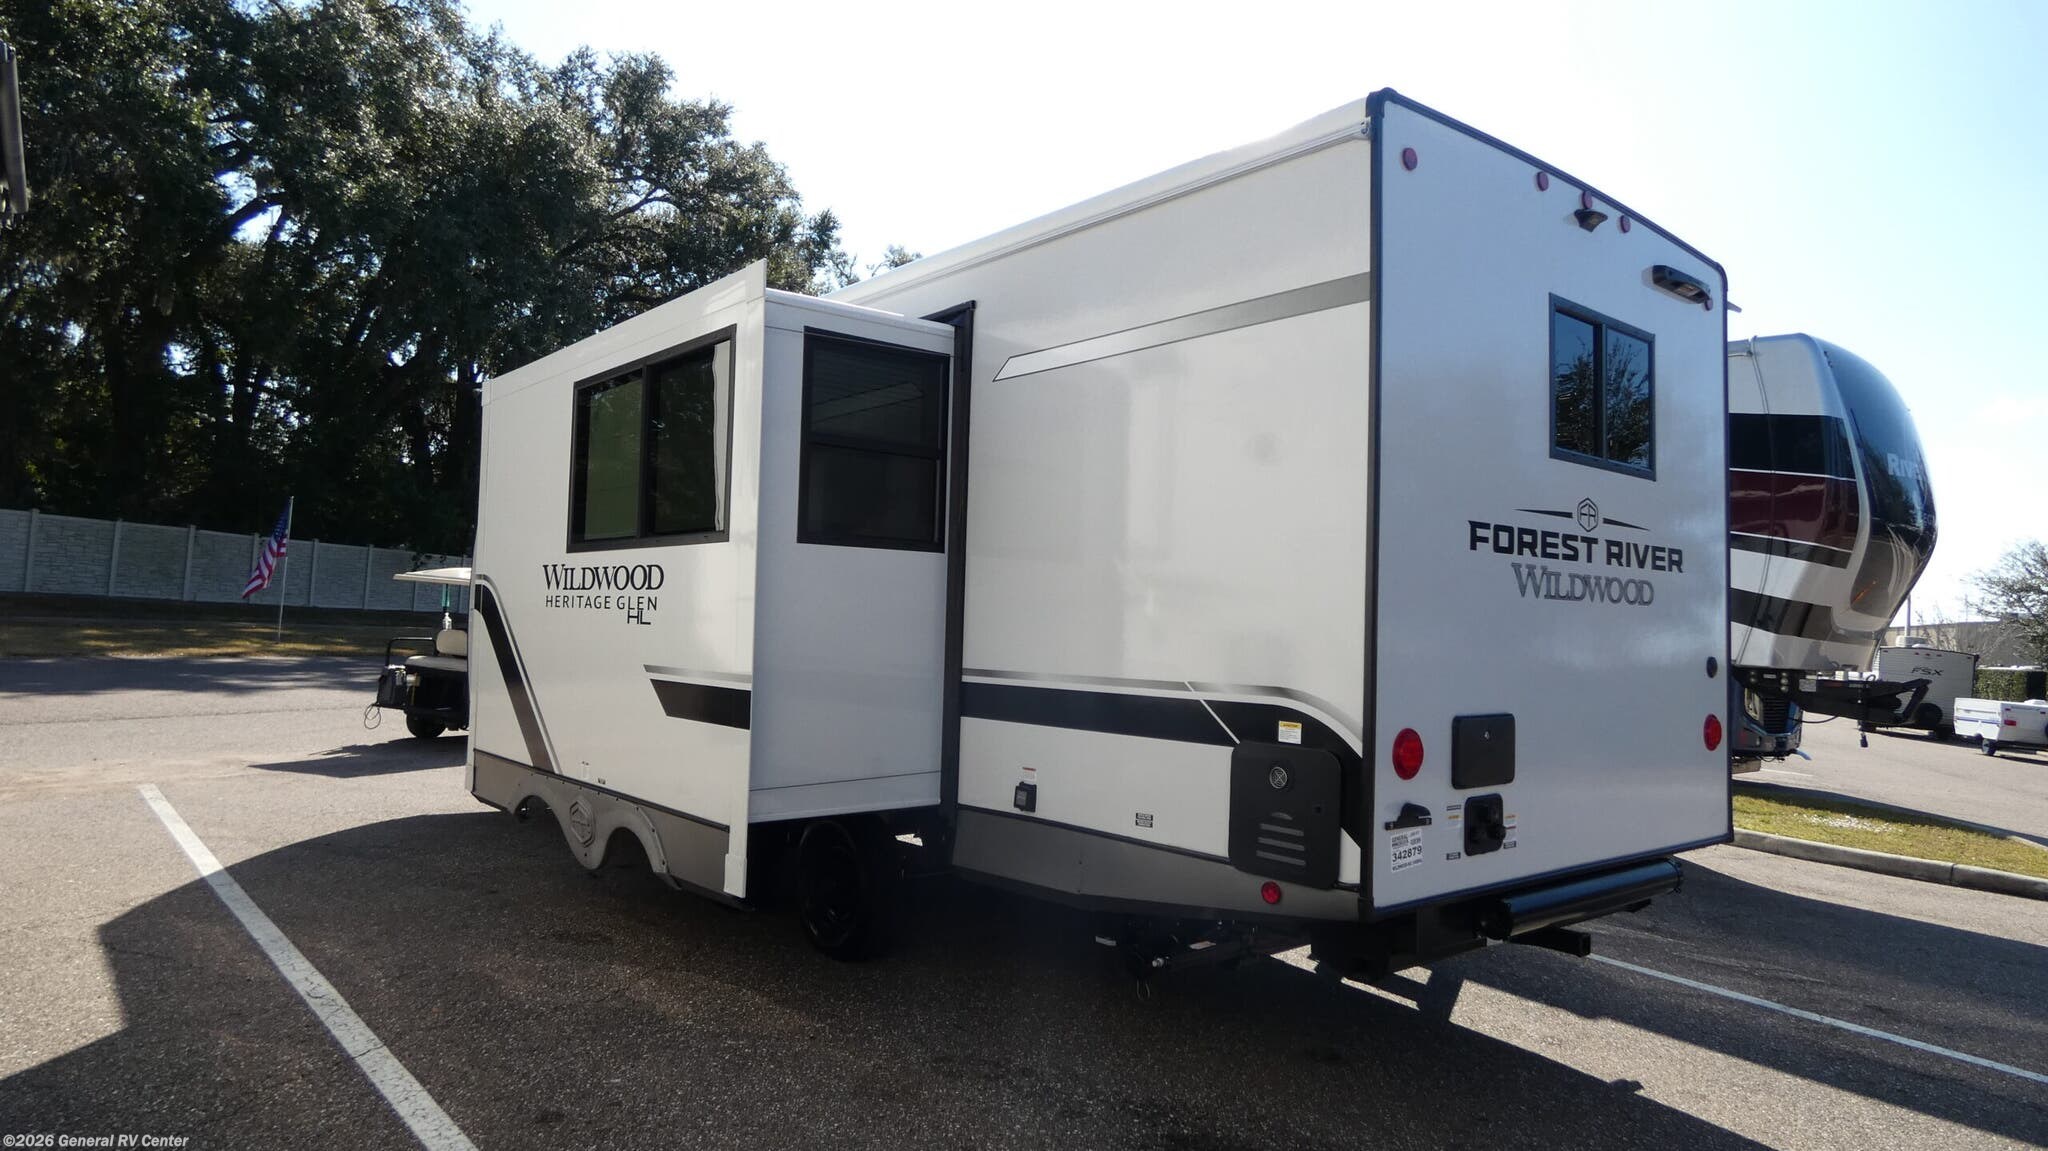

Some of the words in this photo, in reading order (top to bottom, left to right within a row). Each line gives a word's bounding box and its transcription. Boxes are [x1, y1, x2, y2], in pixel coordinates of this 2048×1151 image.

[1468, 520, 1598, 564] FOREST
[1604, 539, 1683, 573] RIVER
[542, 564, 665, 591] WILDWOOD
[1511, 562, 1654, 606] WILDWOOD
[545, 595, 612, 610] HERITAGE
[616, 596, 658, 611] GLEN
[1392, 845, 1422, 863] 342879
